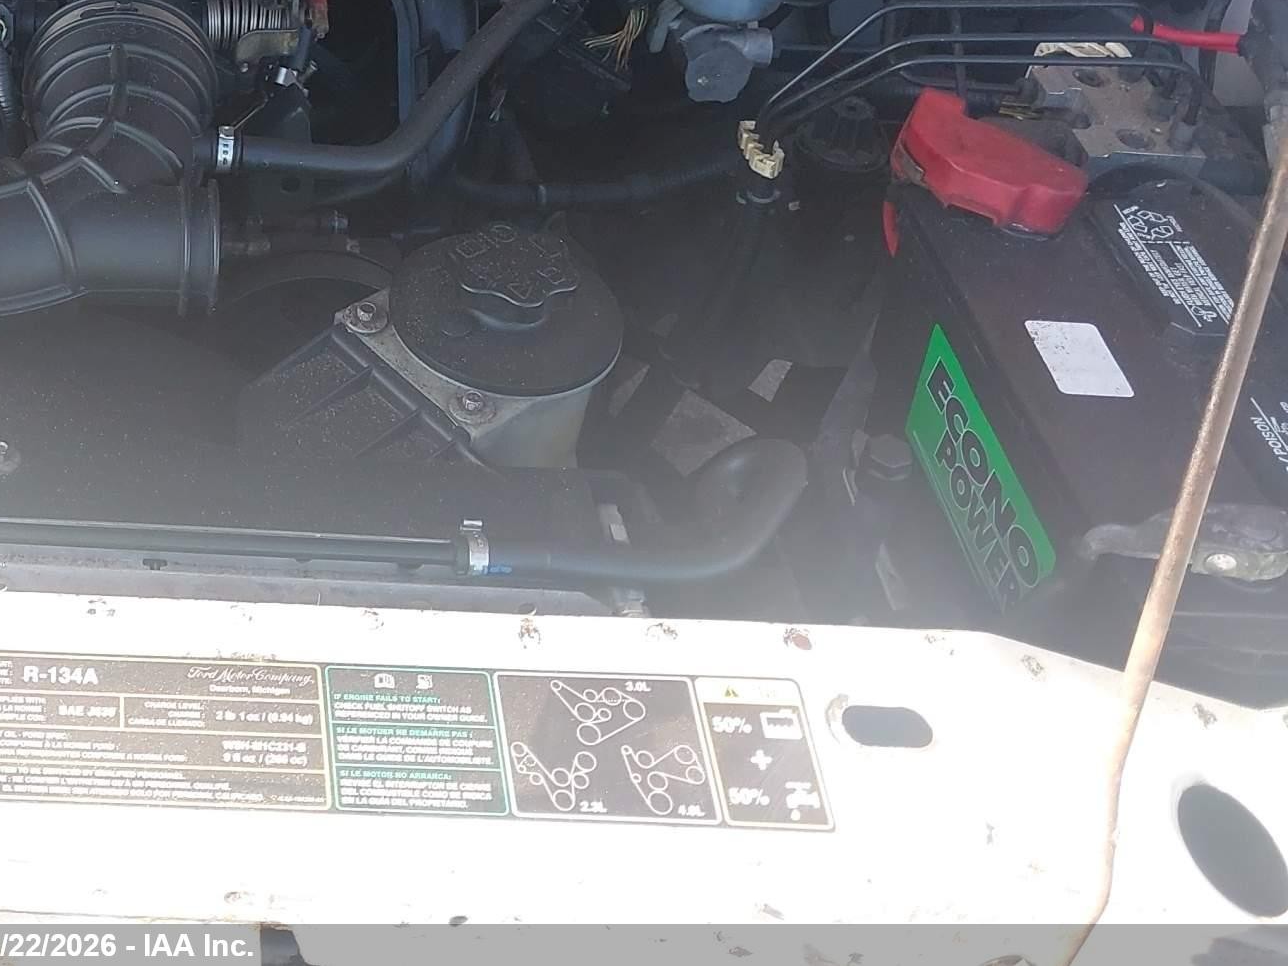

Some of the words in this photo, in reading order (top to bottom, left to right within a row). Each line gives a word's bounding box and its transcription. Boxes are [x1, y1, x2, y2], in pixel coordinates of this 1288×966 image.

[1250, 417, 1288, 455] POISON
[926, 356, 1040, 588] ECONO
[934, 429, 1021, 614] POWER
[24, 666, 98, 684] R-134A
[188, 666, 218, 682] Ford
[214, 667, 253, 683] Motor
[210, 684, 250, 694] Dearborn,
[252, 686, 290, 695] Michigan
[625, 681, 652, 692] 3.0L
[413, 696, 441, 704] START:
[59, 705, 84, 716] SAE
[334, 702, 363, 710] CHECK
[365, 703, 386, 711] FUEL
[427, 705, 458, 713] SWITCH
[460, 706, 472, 714] AS
[216, 710, 222, 722] 2
[225, 710, 236, 722] lb
[239, 710, 245, 722] 1
[246, 711, 260, 723] oz
[711, 716, 753, 734] 50%
[364, 753, 374, 761] LE
[356, 797, 367, 805] LA
[727, 787, 770, 806] 50%
